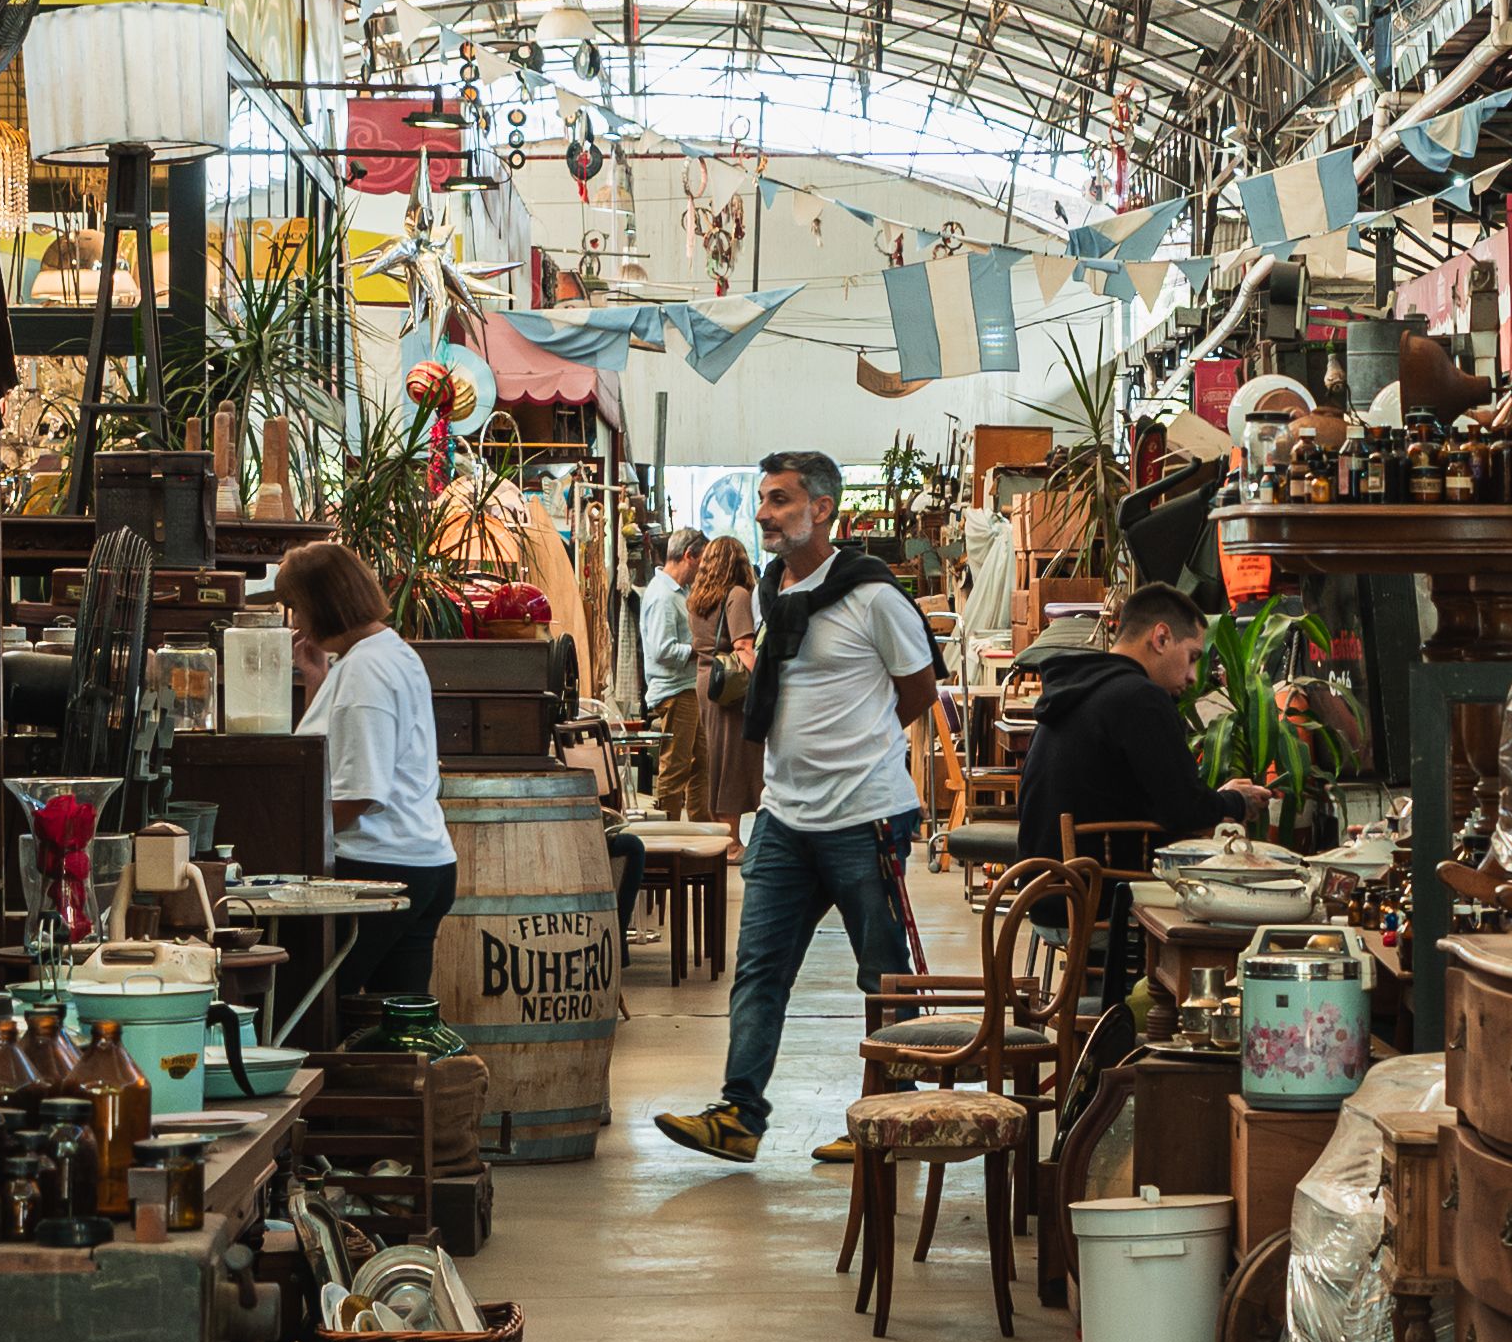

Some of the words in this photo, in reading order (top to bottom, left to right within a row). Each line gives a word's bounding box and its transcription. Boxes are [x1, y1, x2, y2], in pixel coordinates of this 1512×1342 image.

[518, 913, 593, 941] FERNET
[481, 927, 613, 996] BUHERO
[521, 994, 593, 1024] NEGRO
